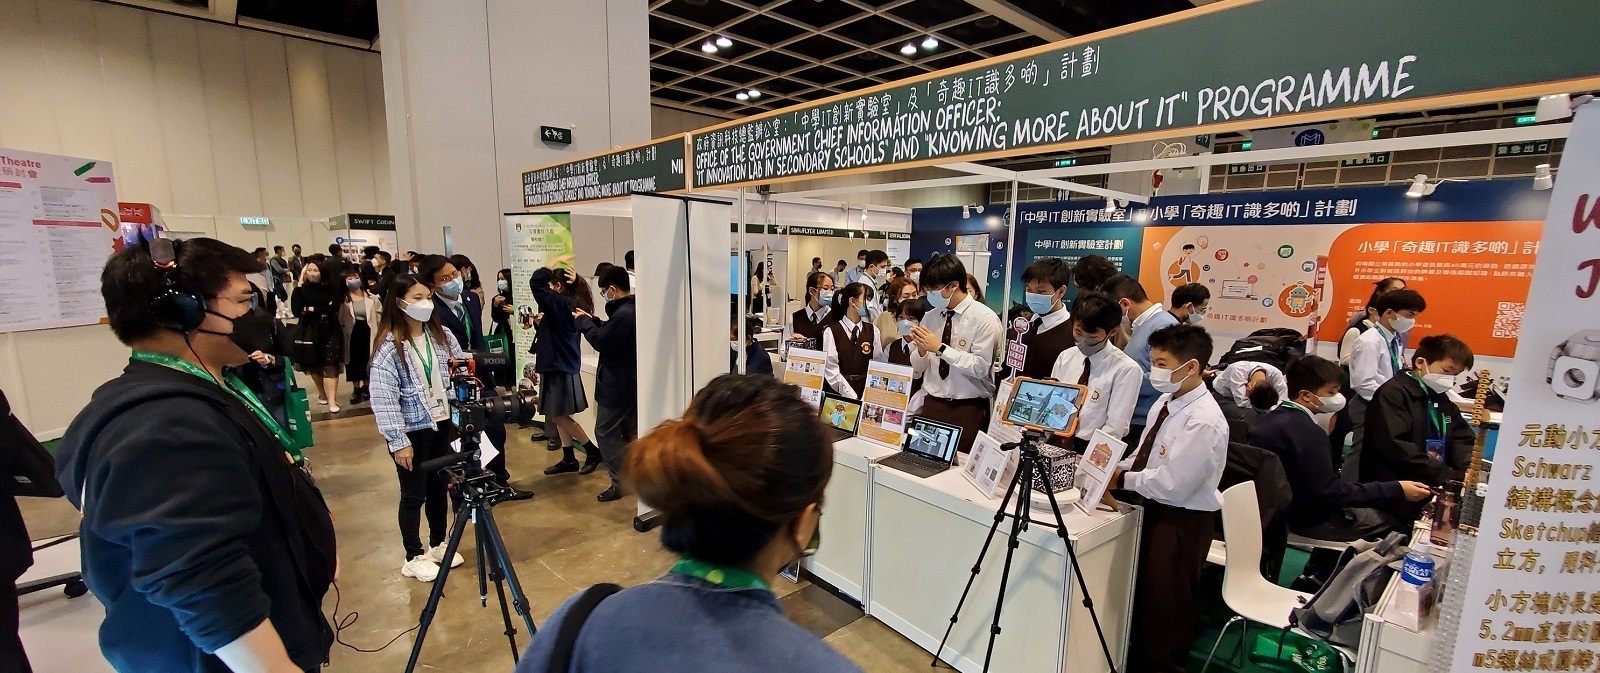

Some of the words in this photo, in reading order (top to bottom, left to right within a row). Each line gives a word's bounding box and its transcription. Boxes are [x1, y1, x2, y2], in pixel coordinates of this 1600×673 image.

[696, 149, 718, 170] OFFICE
[720, 147, 729, 166] OF
[731, 144, 746, 164] THE
[749, 131, 811, 161] GOVERNMENT
[814, 125, 844, 151] CHIEF
[847, 109, 931, 145] INFORMATION
[936, 96, 1001, 130] OFFICER:
[706, 163, 747, 184] INNOVATION
[749, 160, 763, 180] LAB
[765, 159, 774, 177] IN
[776, 148, 831, 175] SECONDARY
[892, 136, 919, 163] AND
[1012, 110, 1070, 147] MORE
[1075, 99, 1149, 140] ABOUT
[1197, 55, 1417, 125] PROGRAMME
[0, 155, 41, 168] Theatre
[1512, 456, 1593, 480] Schwarz
[1504, 486, 1600, 513] 結構概念
